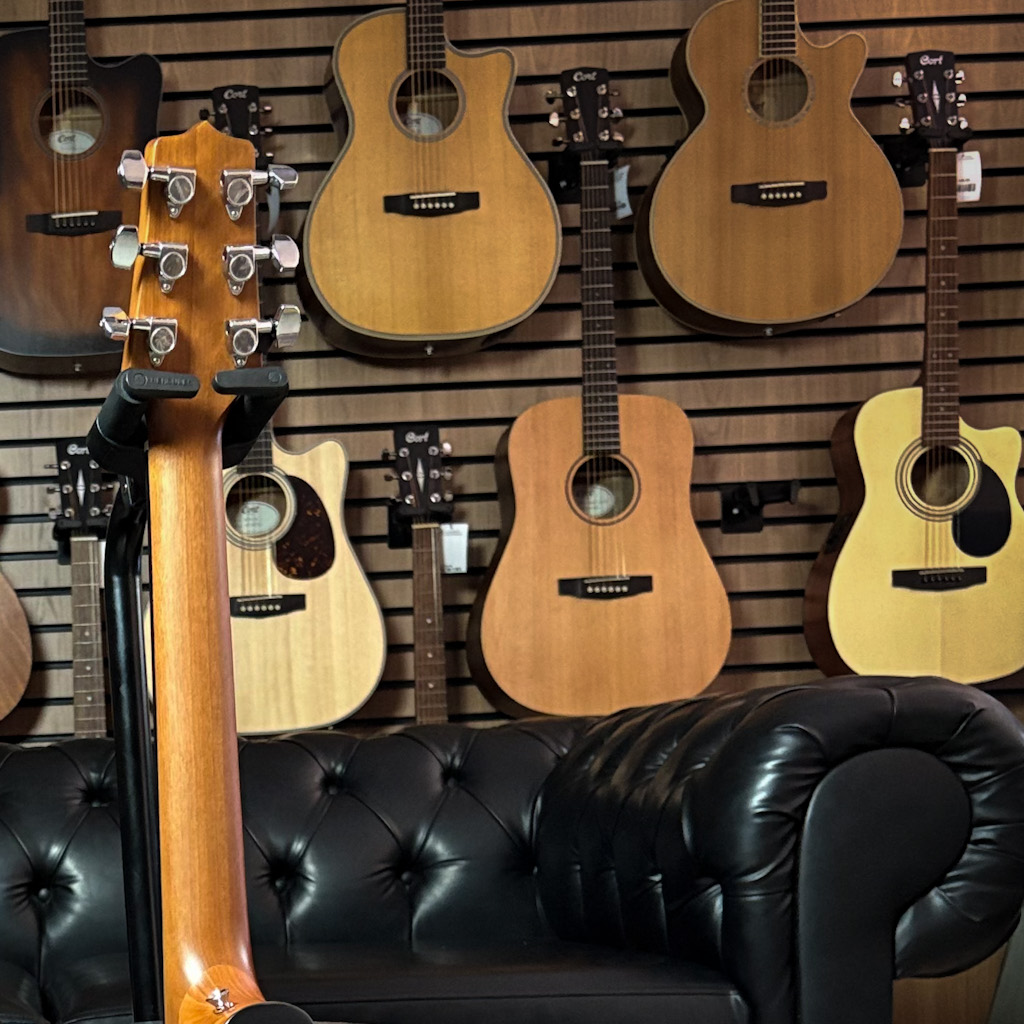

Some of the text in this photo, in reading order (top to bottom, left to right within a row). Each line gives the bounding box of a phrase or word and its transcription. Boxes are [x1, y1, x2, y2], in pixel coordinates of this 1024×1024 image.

[919, 54, 944, 66] Cort
[223, 88, 249, 100] Cort
[405, 431, 430, 444] Cort
